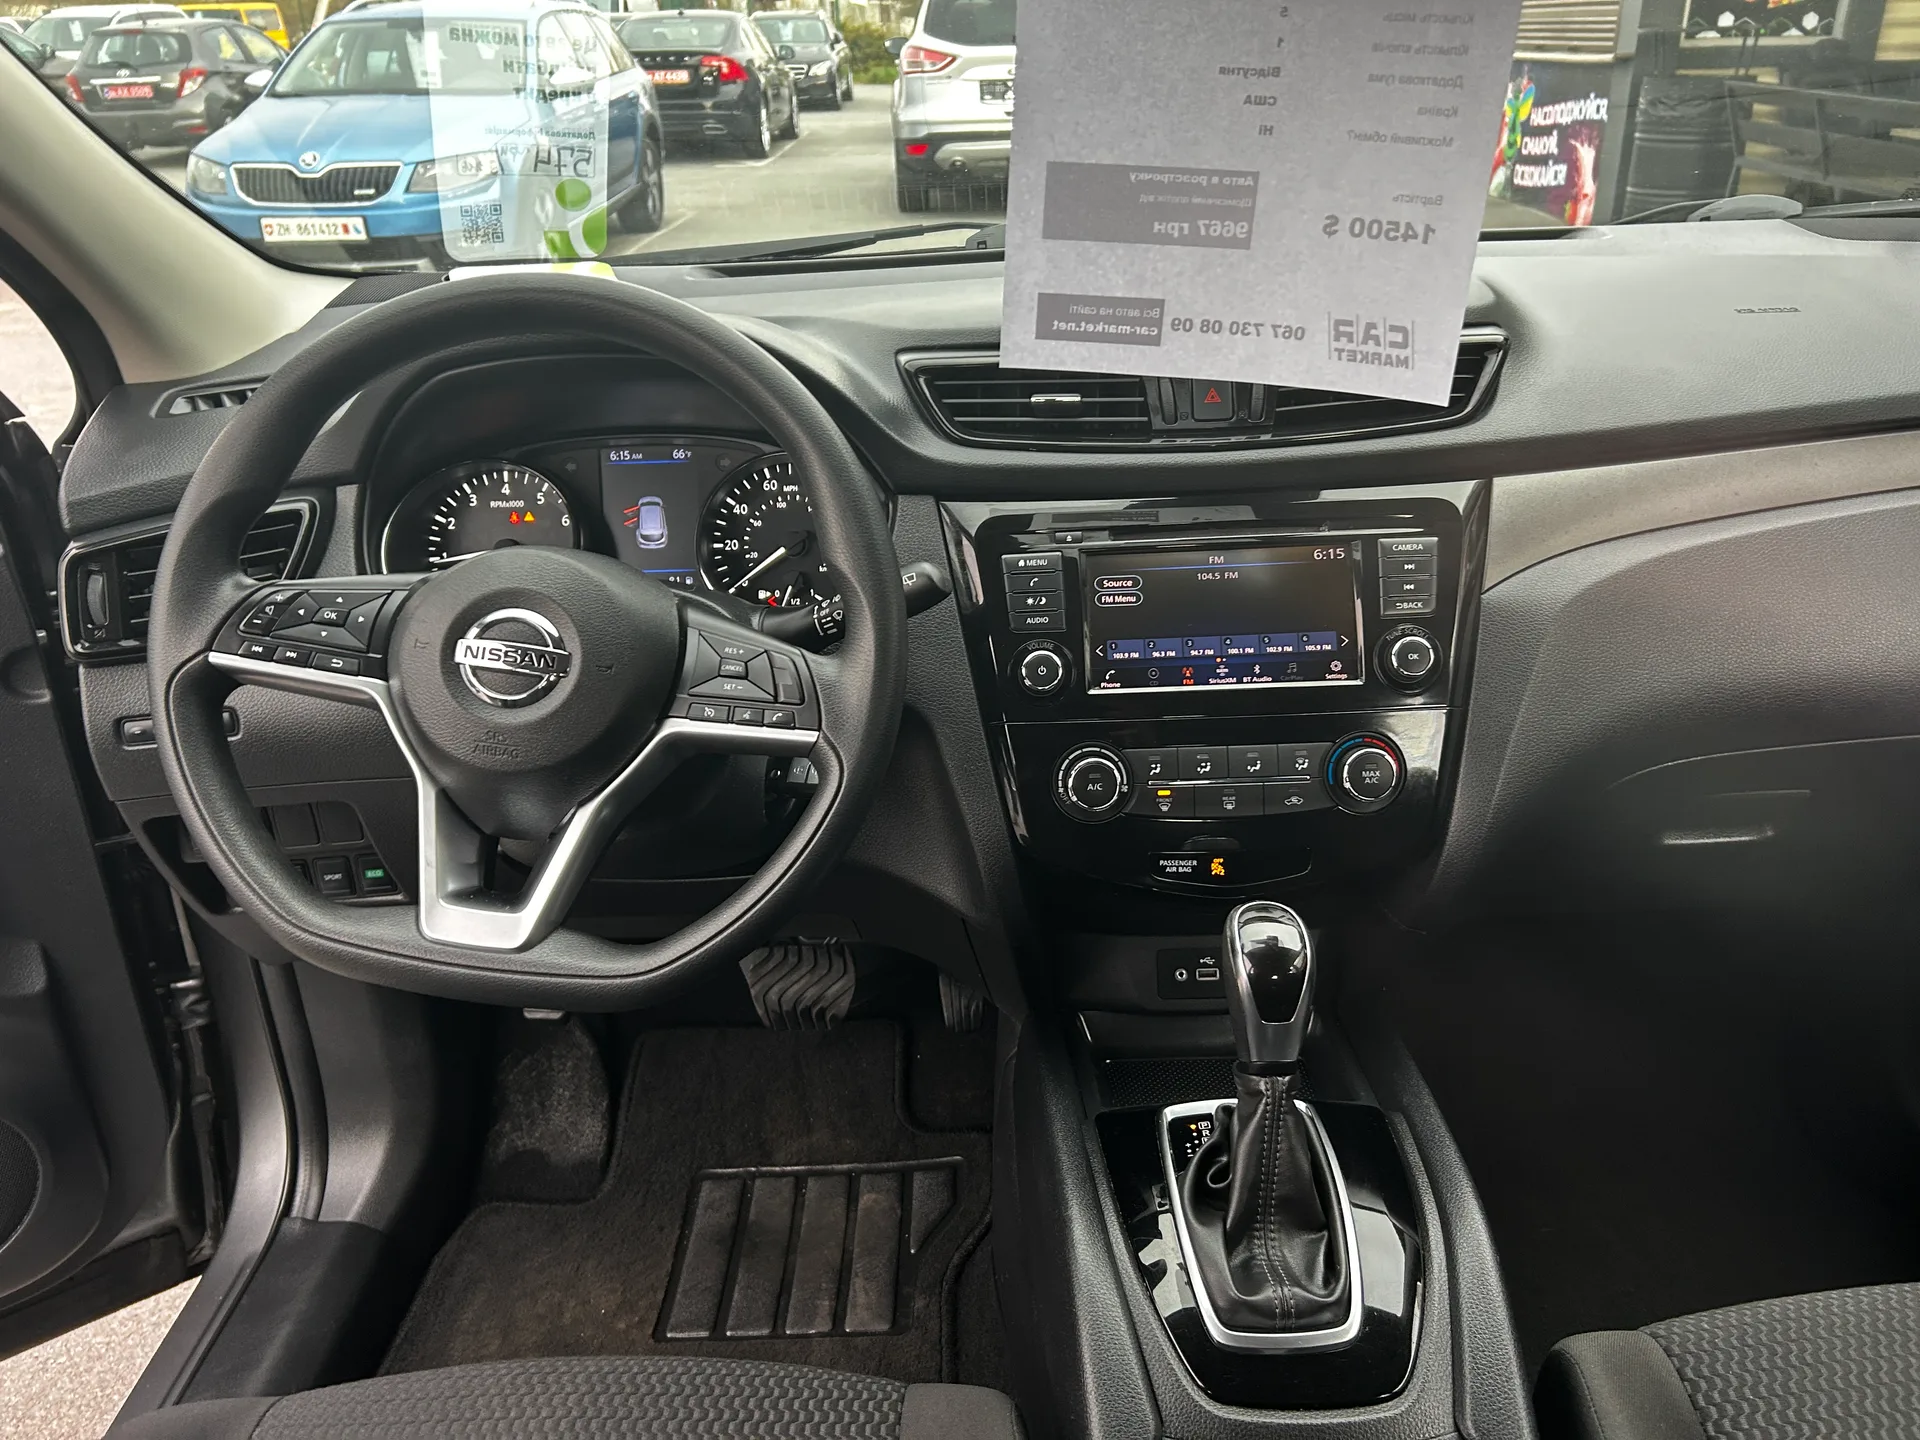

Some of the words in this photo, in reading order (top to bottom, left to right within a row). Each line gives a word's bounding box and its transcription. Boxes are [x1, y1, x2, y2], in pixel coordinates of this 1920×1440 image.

[609, 450, 631, 461] 6:15
[501, 483, 510, 495] 4
[762, 480, 778, 491] 60
[468, 494, 478, 506] 3
[536, 492, 545, 505] 5
[733, 504, 748, 515] 40
[776, 501, 787, 509] 100
[447, 517, 456, 530] 2
[561, 515, 570, 527] 6
[724, 539, 739, 551] 20
[1392, 543, 1424, 552] CAMERA
[1313, 548, 1345, 560] 6:15
[1026, 558, 1048, 567] MENU
[1209, 556, 1224, 564] FM
[1103, 579, 1133, 588] Source
[1101, 596, 1114, 604] FM
[1114, 595, 1136, 603] Menu
[1403, 601, 1423, 609] BACK
[323, 610, 338, 621] OK
[1026, 616, 1049, 624] AUDIO
[724, 647, 738, 655] RES
[1027, 642, 1054, 651] VOLUME
[463, 645, 557, 669] NISSAN
[721, 664, 743, 672] CANCEL
[1087, 783, 1103, 791] A/C
